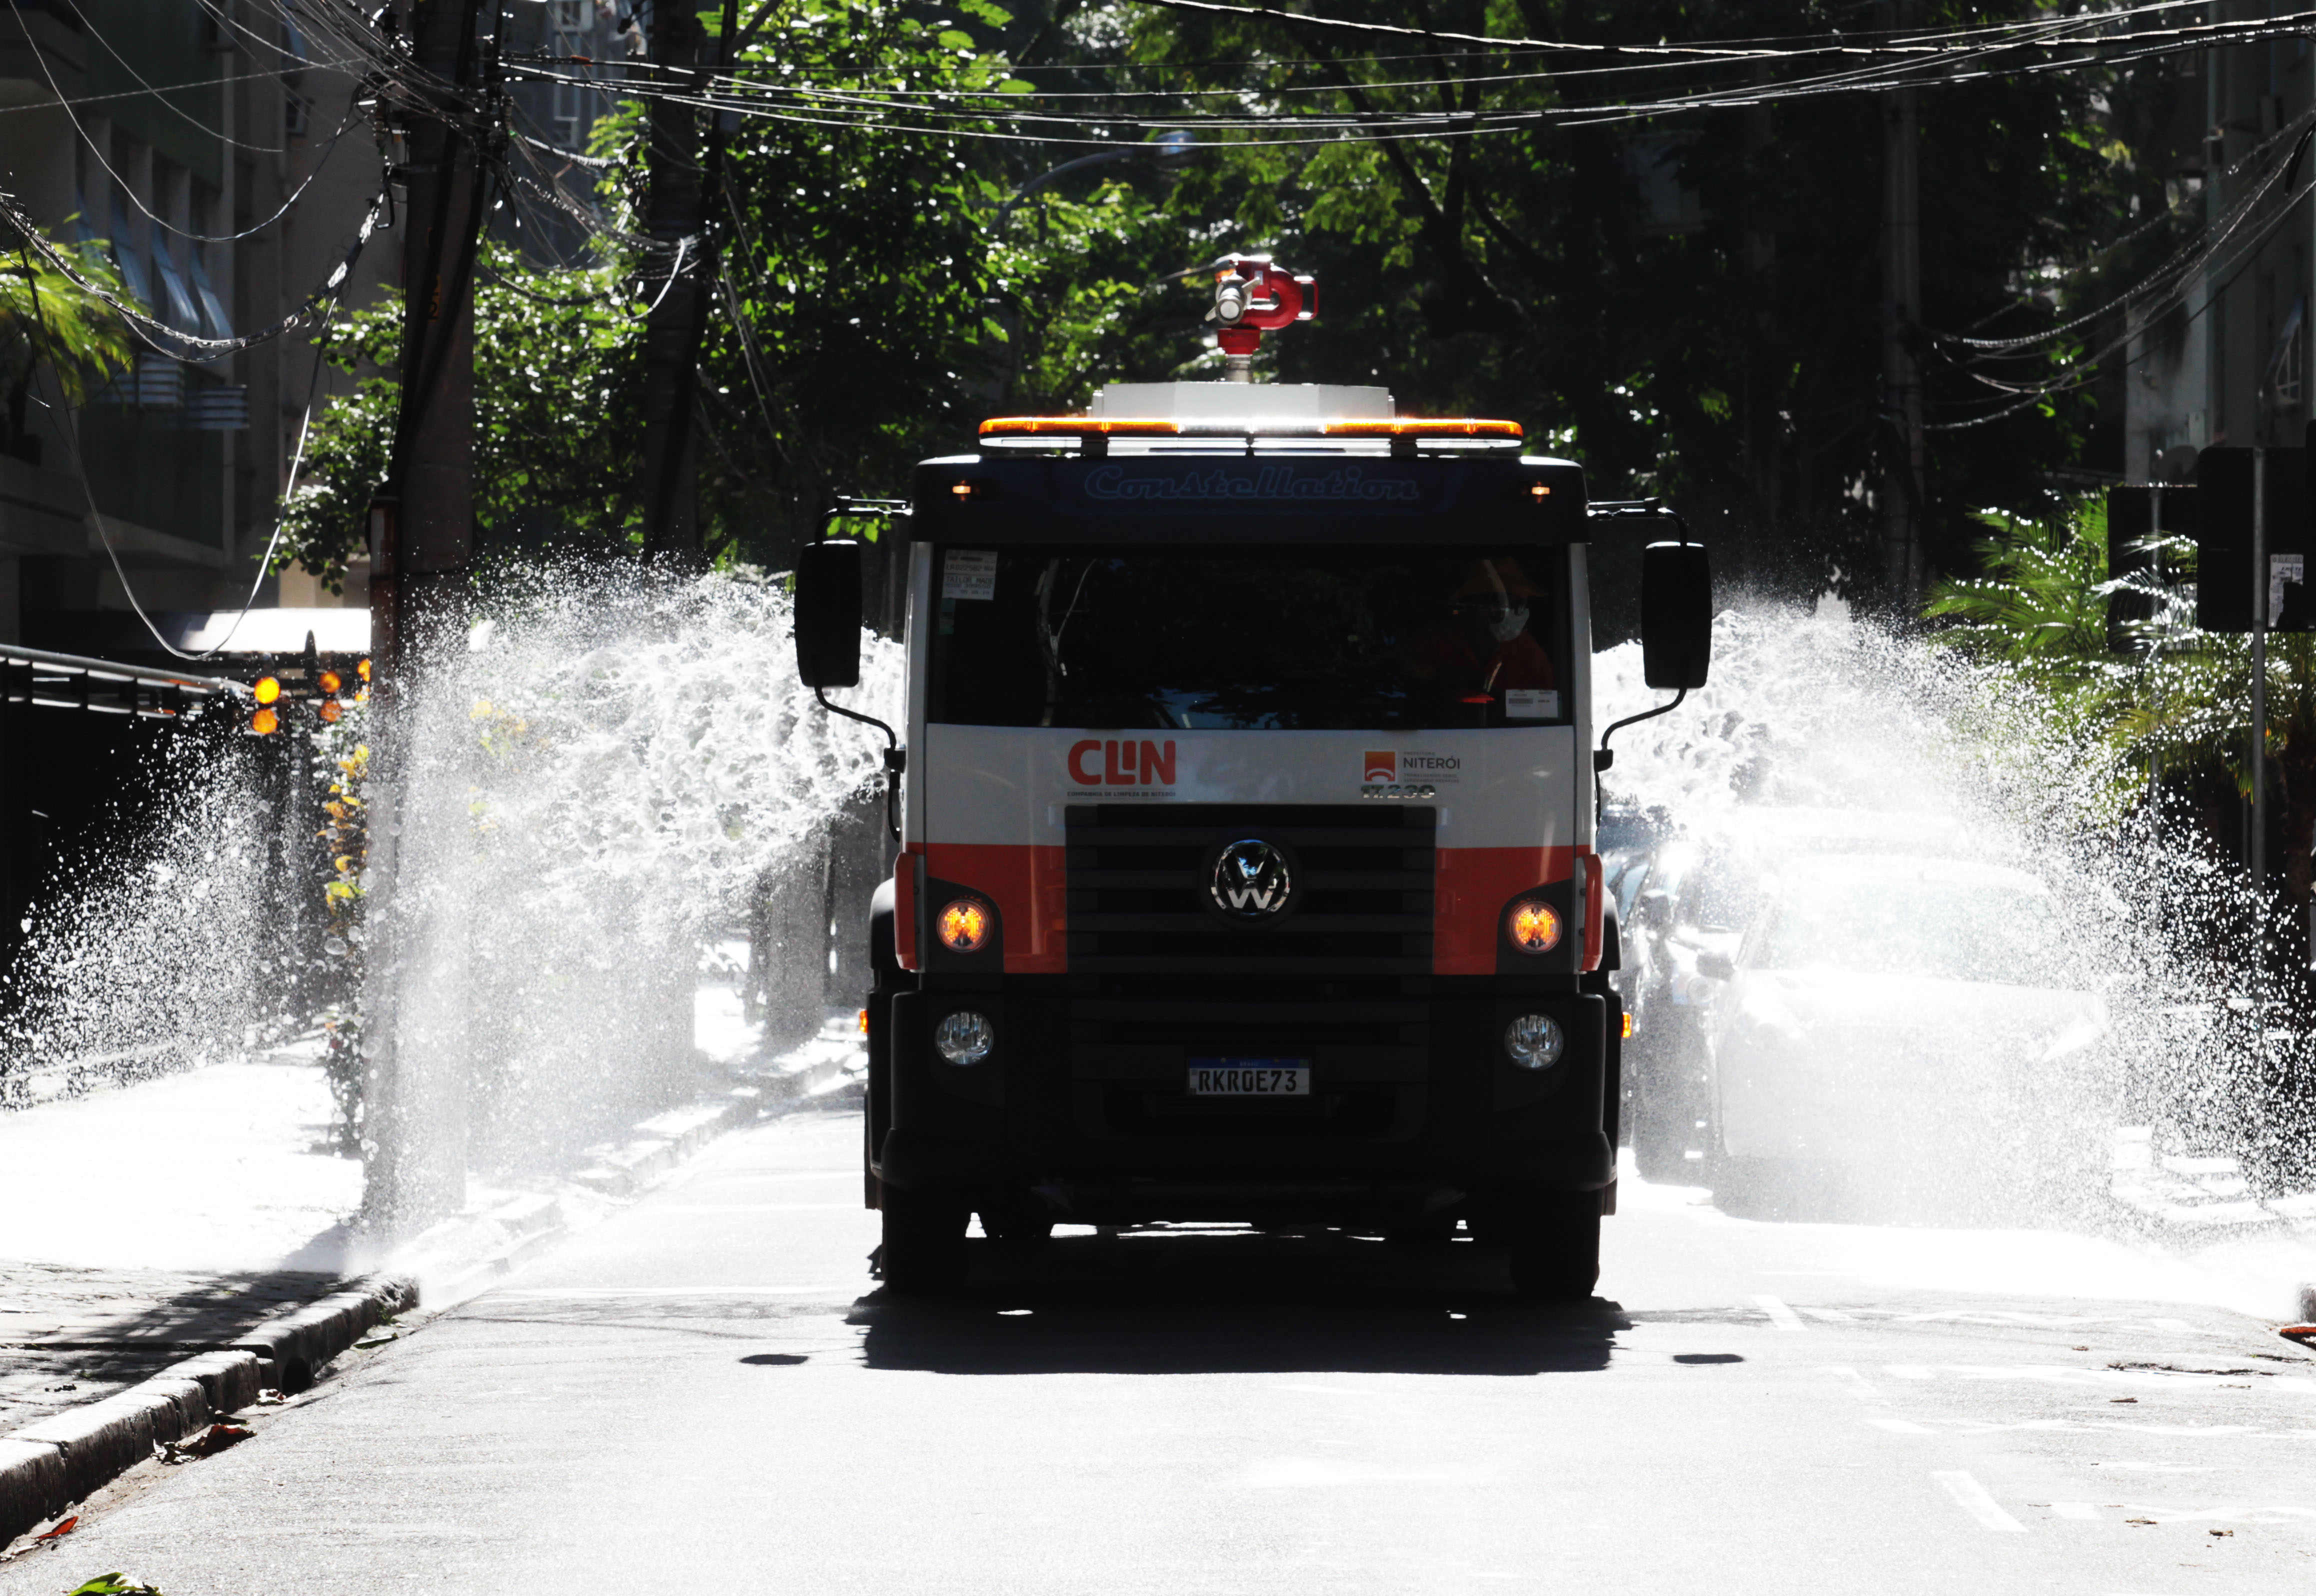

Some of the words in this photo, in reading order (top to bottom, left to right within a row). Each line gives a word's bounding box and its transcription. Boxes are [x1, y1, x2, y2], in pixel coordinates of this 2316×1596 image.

[1084, 465, 1420, 499] Constellation
[1068, 740, 1176, 785] CLIN
[1403, 755, 1460, 769] NITERÓI
